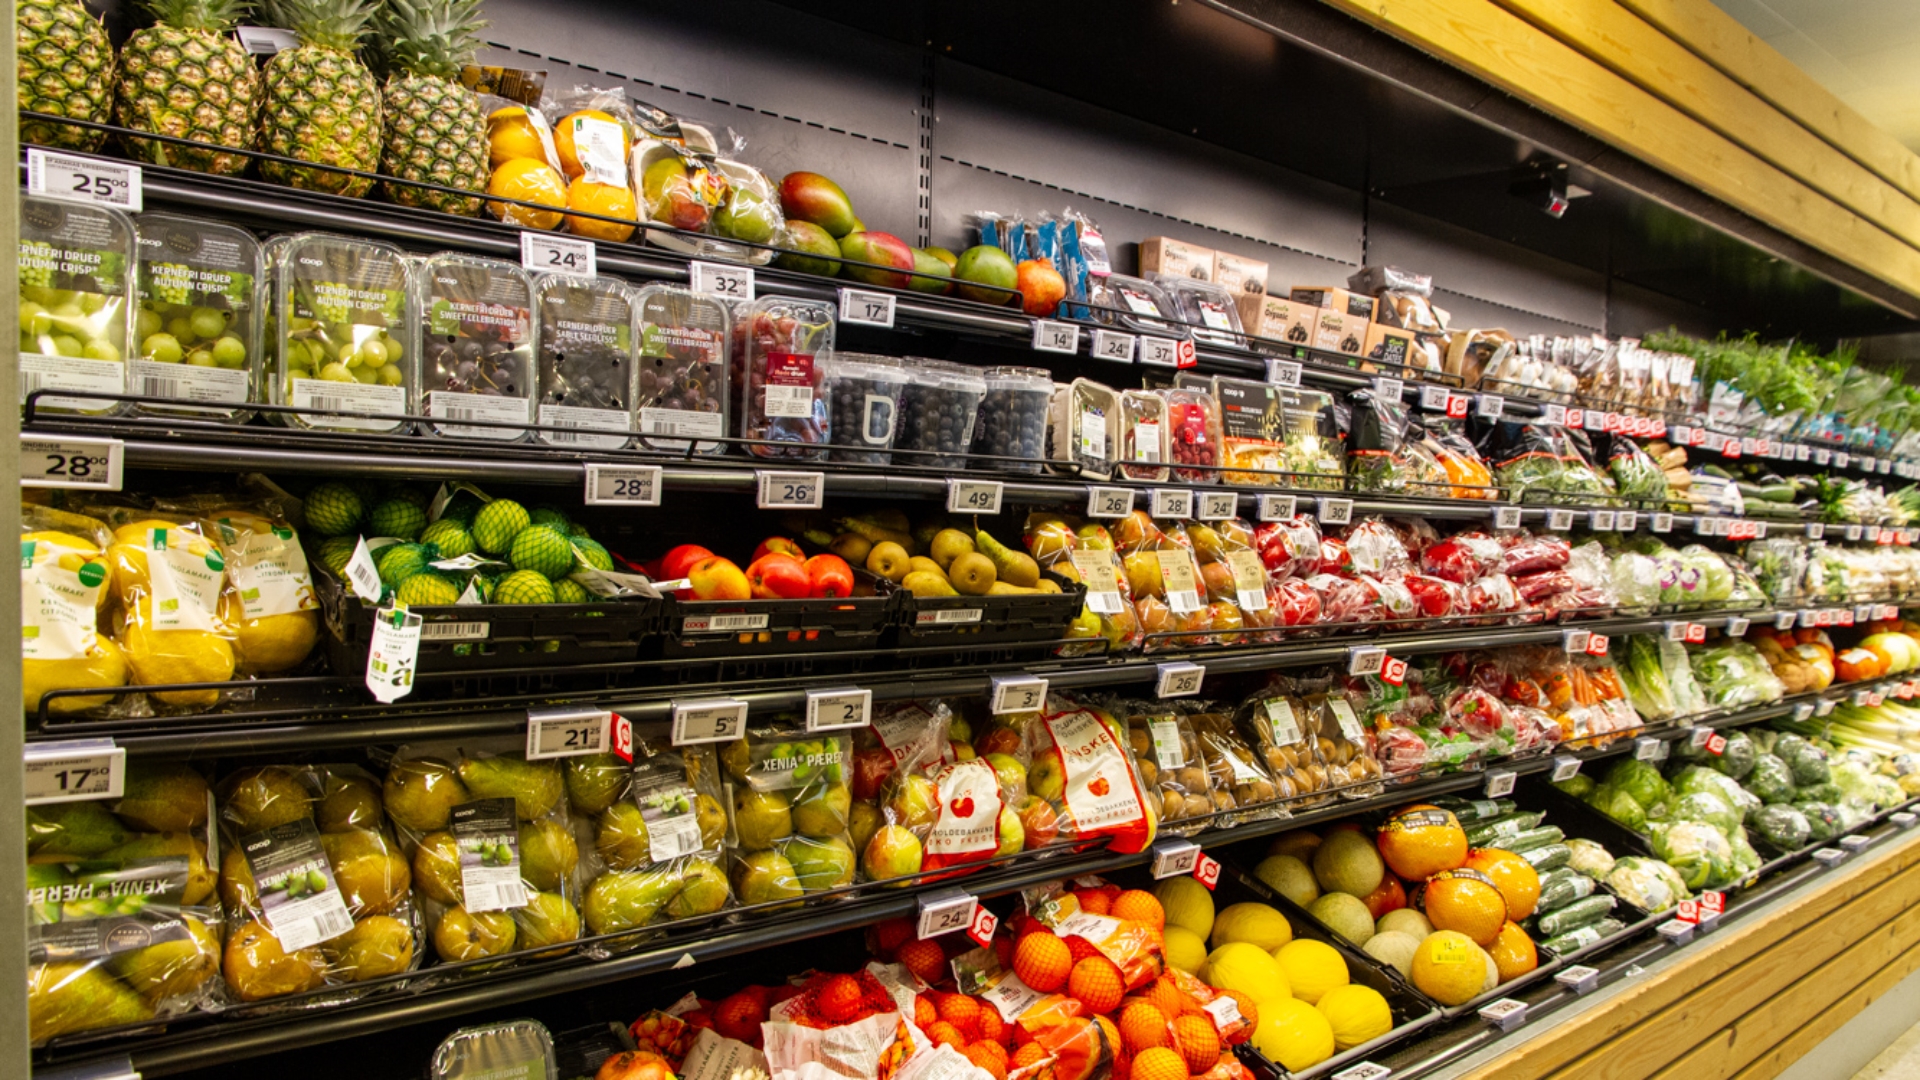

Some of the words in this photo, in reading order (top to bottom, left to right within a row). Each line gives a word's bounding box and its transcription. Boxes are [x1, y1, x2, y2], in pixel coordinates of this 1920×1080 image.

[64, 249, 102, 264] DRUER
[300, 257, 324, 267] coop
[151, 265, 199, 280] KERNEFRI
[199, 271, 232, 284] DRUER
[437, 277, 458, 286] coop
[153, 276, 195, 291] AUTUMN
[313, 284, 357, 298] KERNEFRI
[357, 289, 387, 302] DRUER
[316, 295, 354, 309] AUTUMN
[449, 301, 488, 315] KERNEFRI
[488, 306, 514, 318] DRUER
[1264, 309, 1289, 321] Organic
[439, 310, 467, 321] SWEET
[467, 313, 517, 328] CELEBRATION
[1262, 317, 1287, 332] Juicy
[556, 320, 592, 332] KERNEFRI
[592, 323, 617, 335] DRUER
[1320, 321, 1343, 332] Organic
[650, 334, 672, 344] SWEET
[1318, 329, 1341, 342] Juicy
[684, 620, 709, 630] coop
[247, 838, 272, 852] coop
[151, 919, 182, 931] coop
